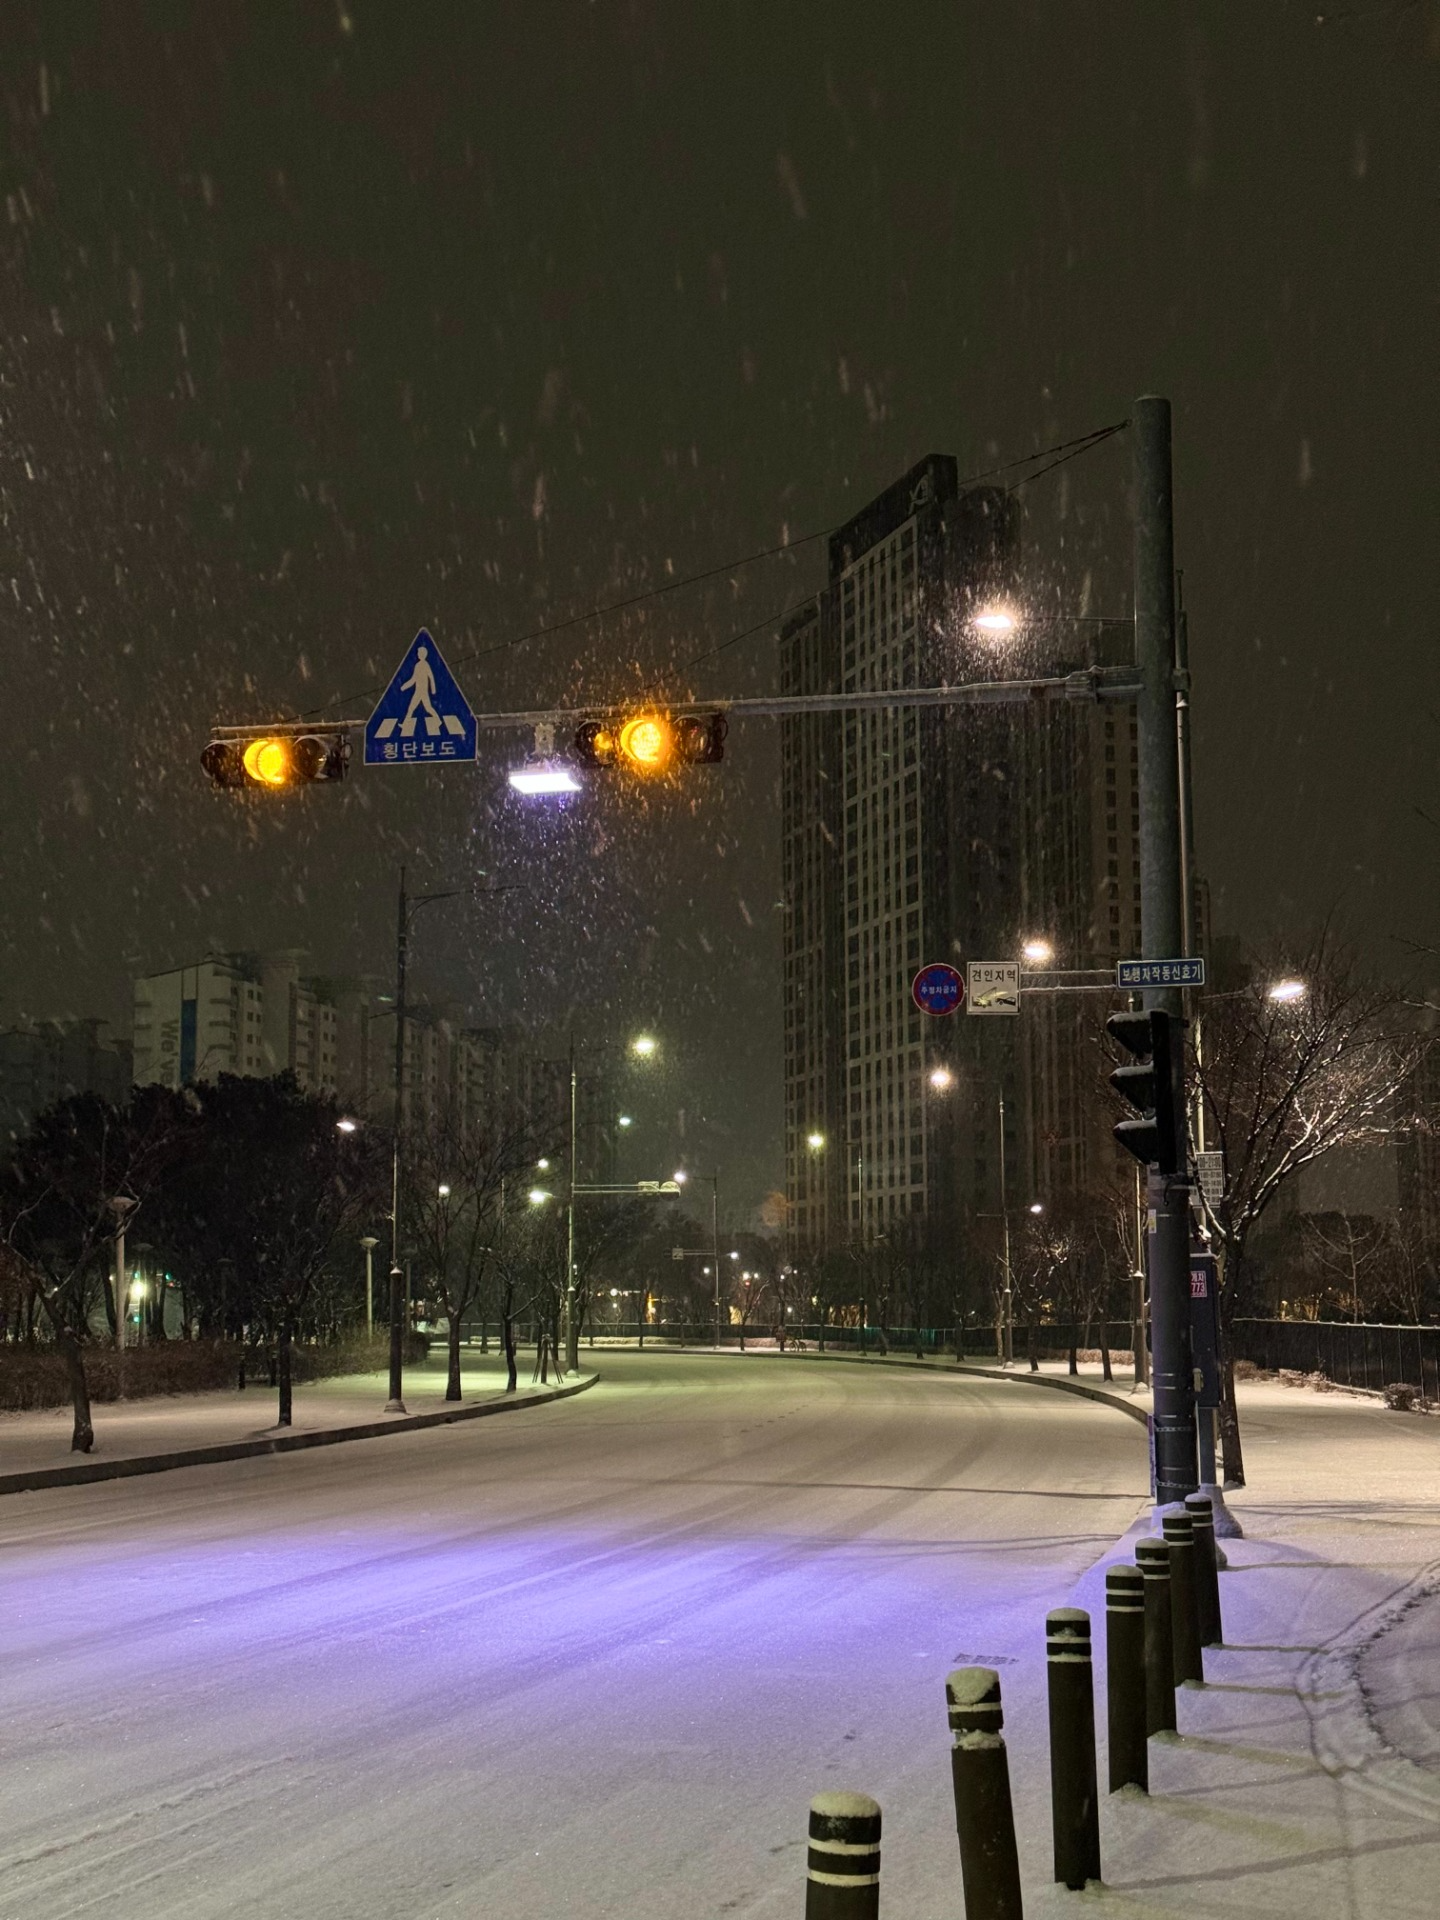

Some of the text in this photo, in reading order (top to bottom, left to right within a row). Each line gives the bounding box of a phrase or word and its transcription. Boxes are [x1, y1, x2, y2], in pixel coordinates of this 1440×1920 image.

[383, 741, 456, 759] 횡단보도
[972, 969, 1016, 982] 견인지역
[1122, 964, 1201, 982] 보행자작동신호기
